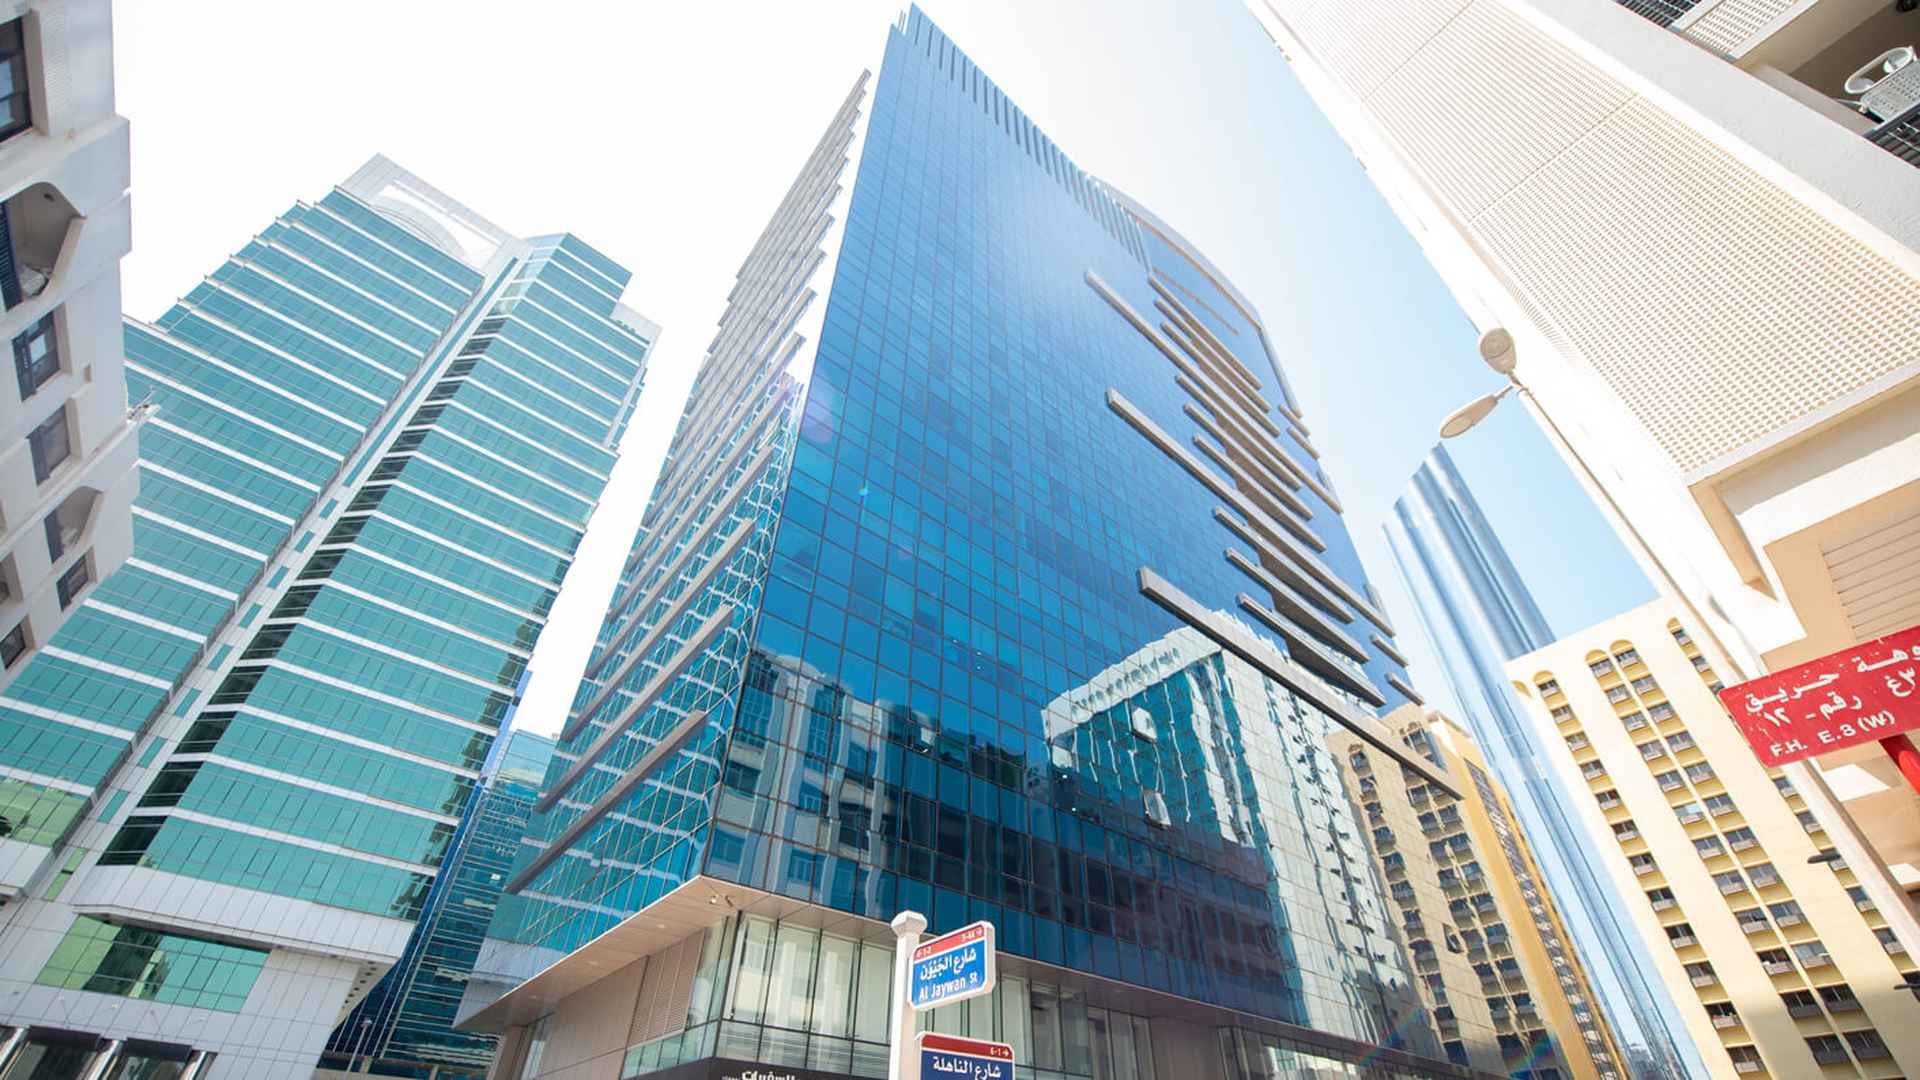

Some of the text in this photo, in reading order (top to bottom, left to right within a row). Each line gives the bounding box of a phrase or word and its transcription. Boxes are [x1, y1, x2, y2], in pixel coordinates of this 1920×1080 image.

[1820, 691, 1862, 720] رقم
[1769, 739, 1808, 757] F.H.
[953, 947, 977, 975] شارع
[919, 971, 978, 1001] Al Jaywan St
